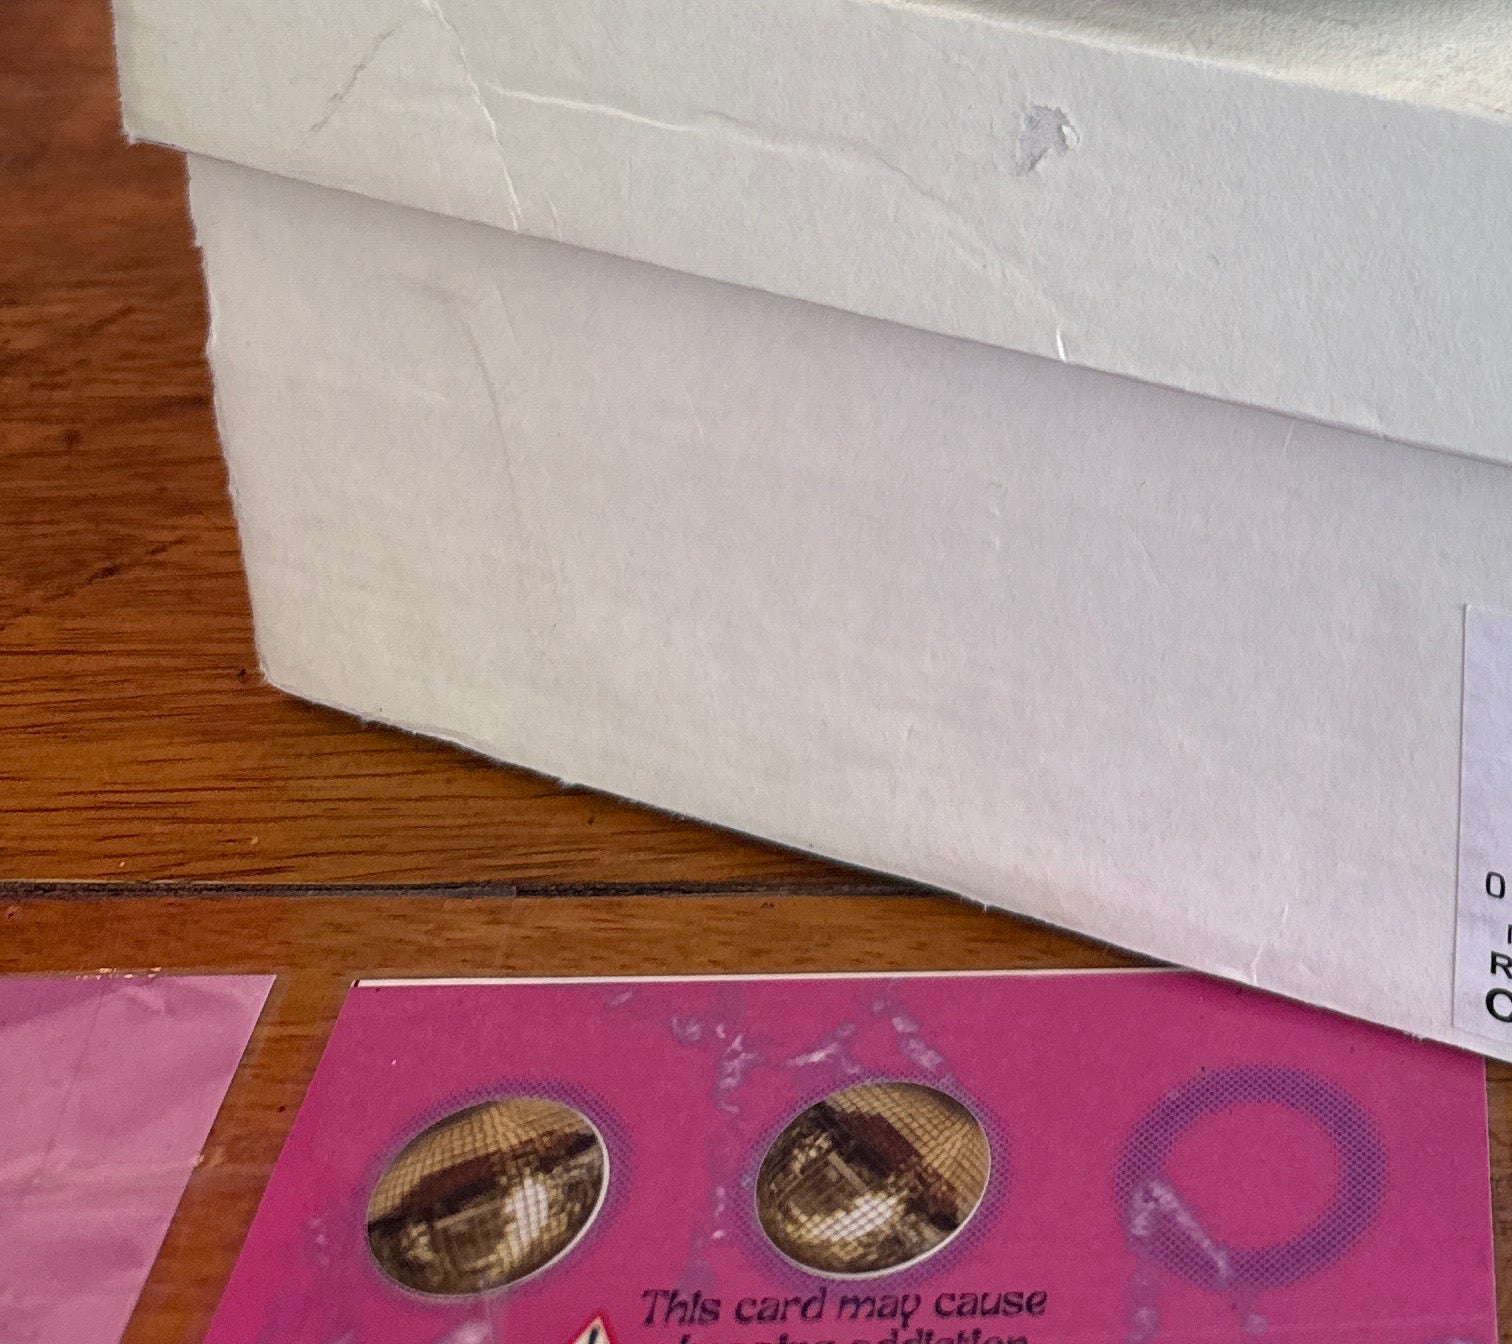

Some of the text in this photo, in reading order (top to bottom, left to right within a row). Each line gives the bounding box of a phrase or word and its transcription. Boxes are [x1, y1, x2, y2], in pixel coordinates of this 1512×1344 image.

[1485, 871, 1506, 900] 0
[641, 1285, 1048, 1332] This card may cause
